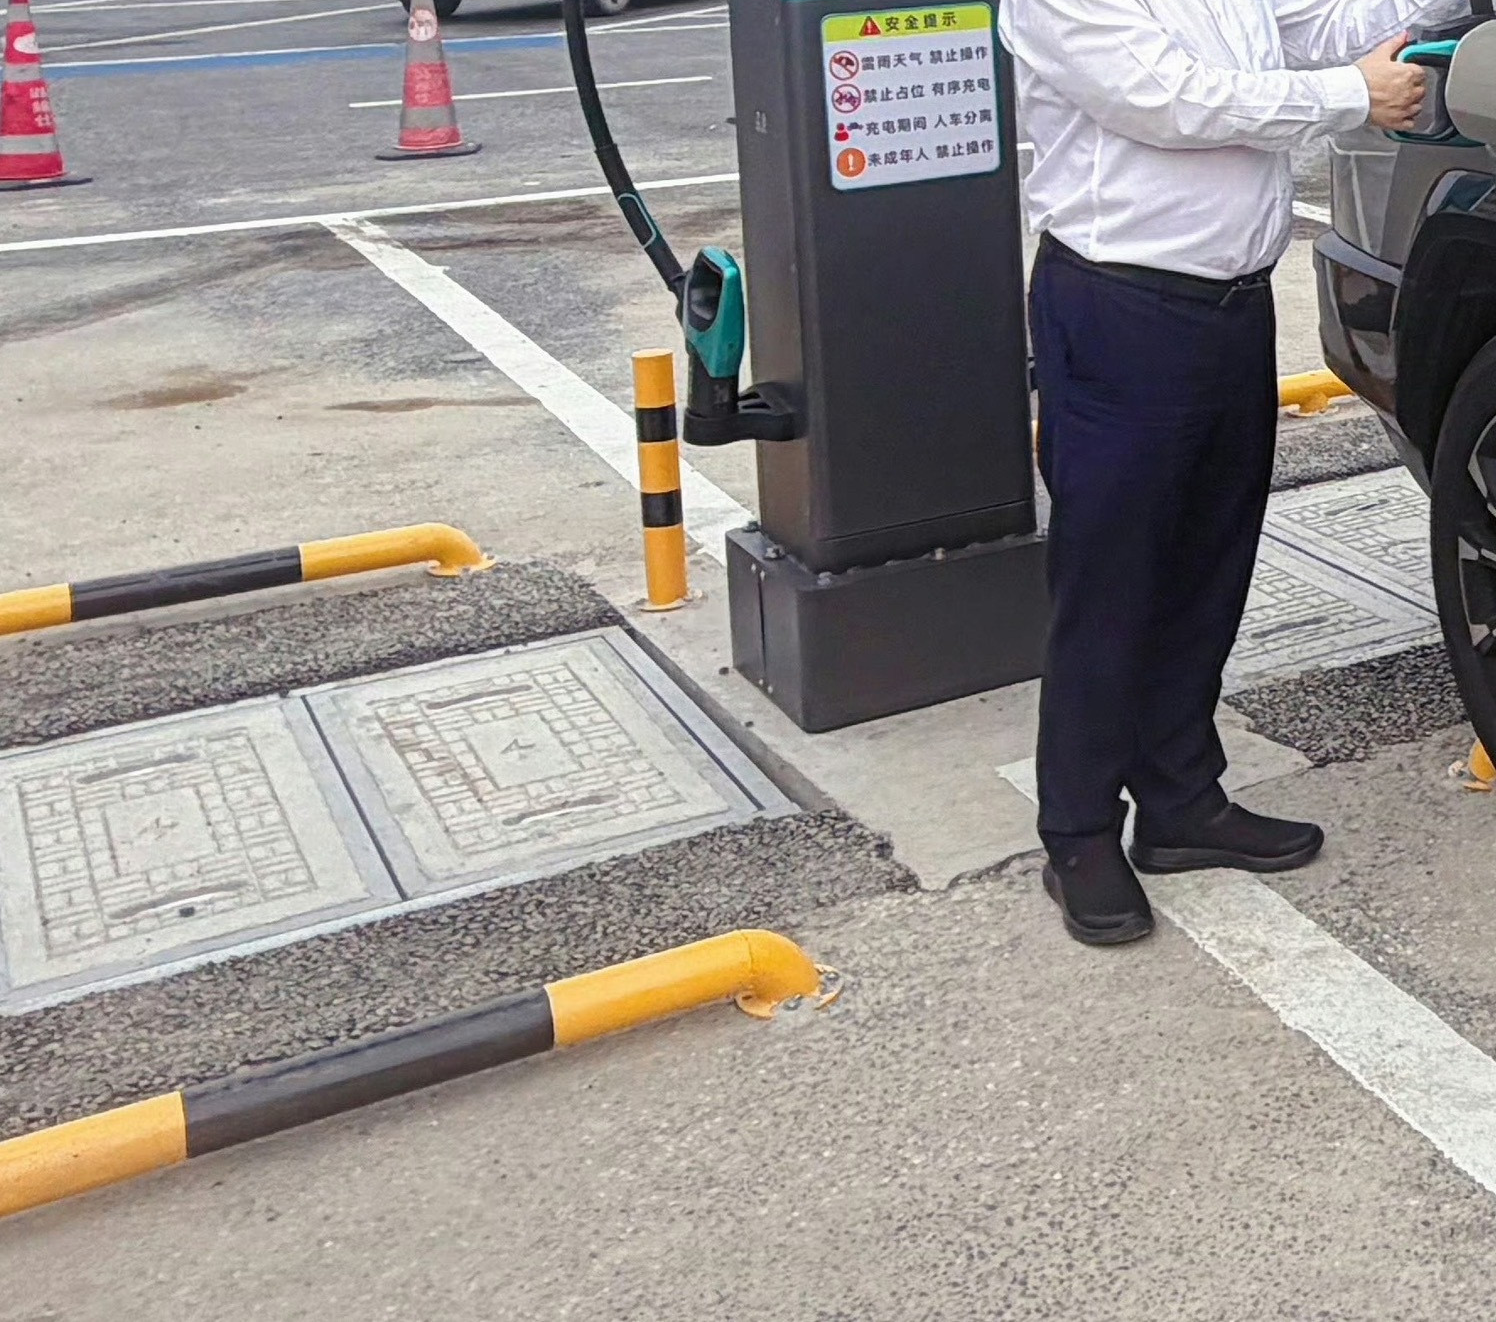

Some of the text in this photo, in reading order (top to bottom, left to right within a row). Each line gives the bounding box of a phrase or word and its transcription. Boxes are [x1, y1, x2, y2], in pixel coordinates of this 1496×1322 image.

[885, 11, 958, 32] 安全提示
[861, 46, 988, 71] 雷雨天气 禁止操作
[863, 78, 991, 104] 禁止占位 有序充电
[865, 109, 993, 137] 充电期间 人车分离
[867, 139, 995, 168] 未成年人 禁止操作
